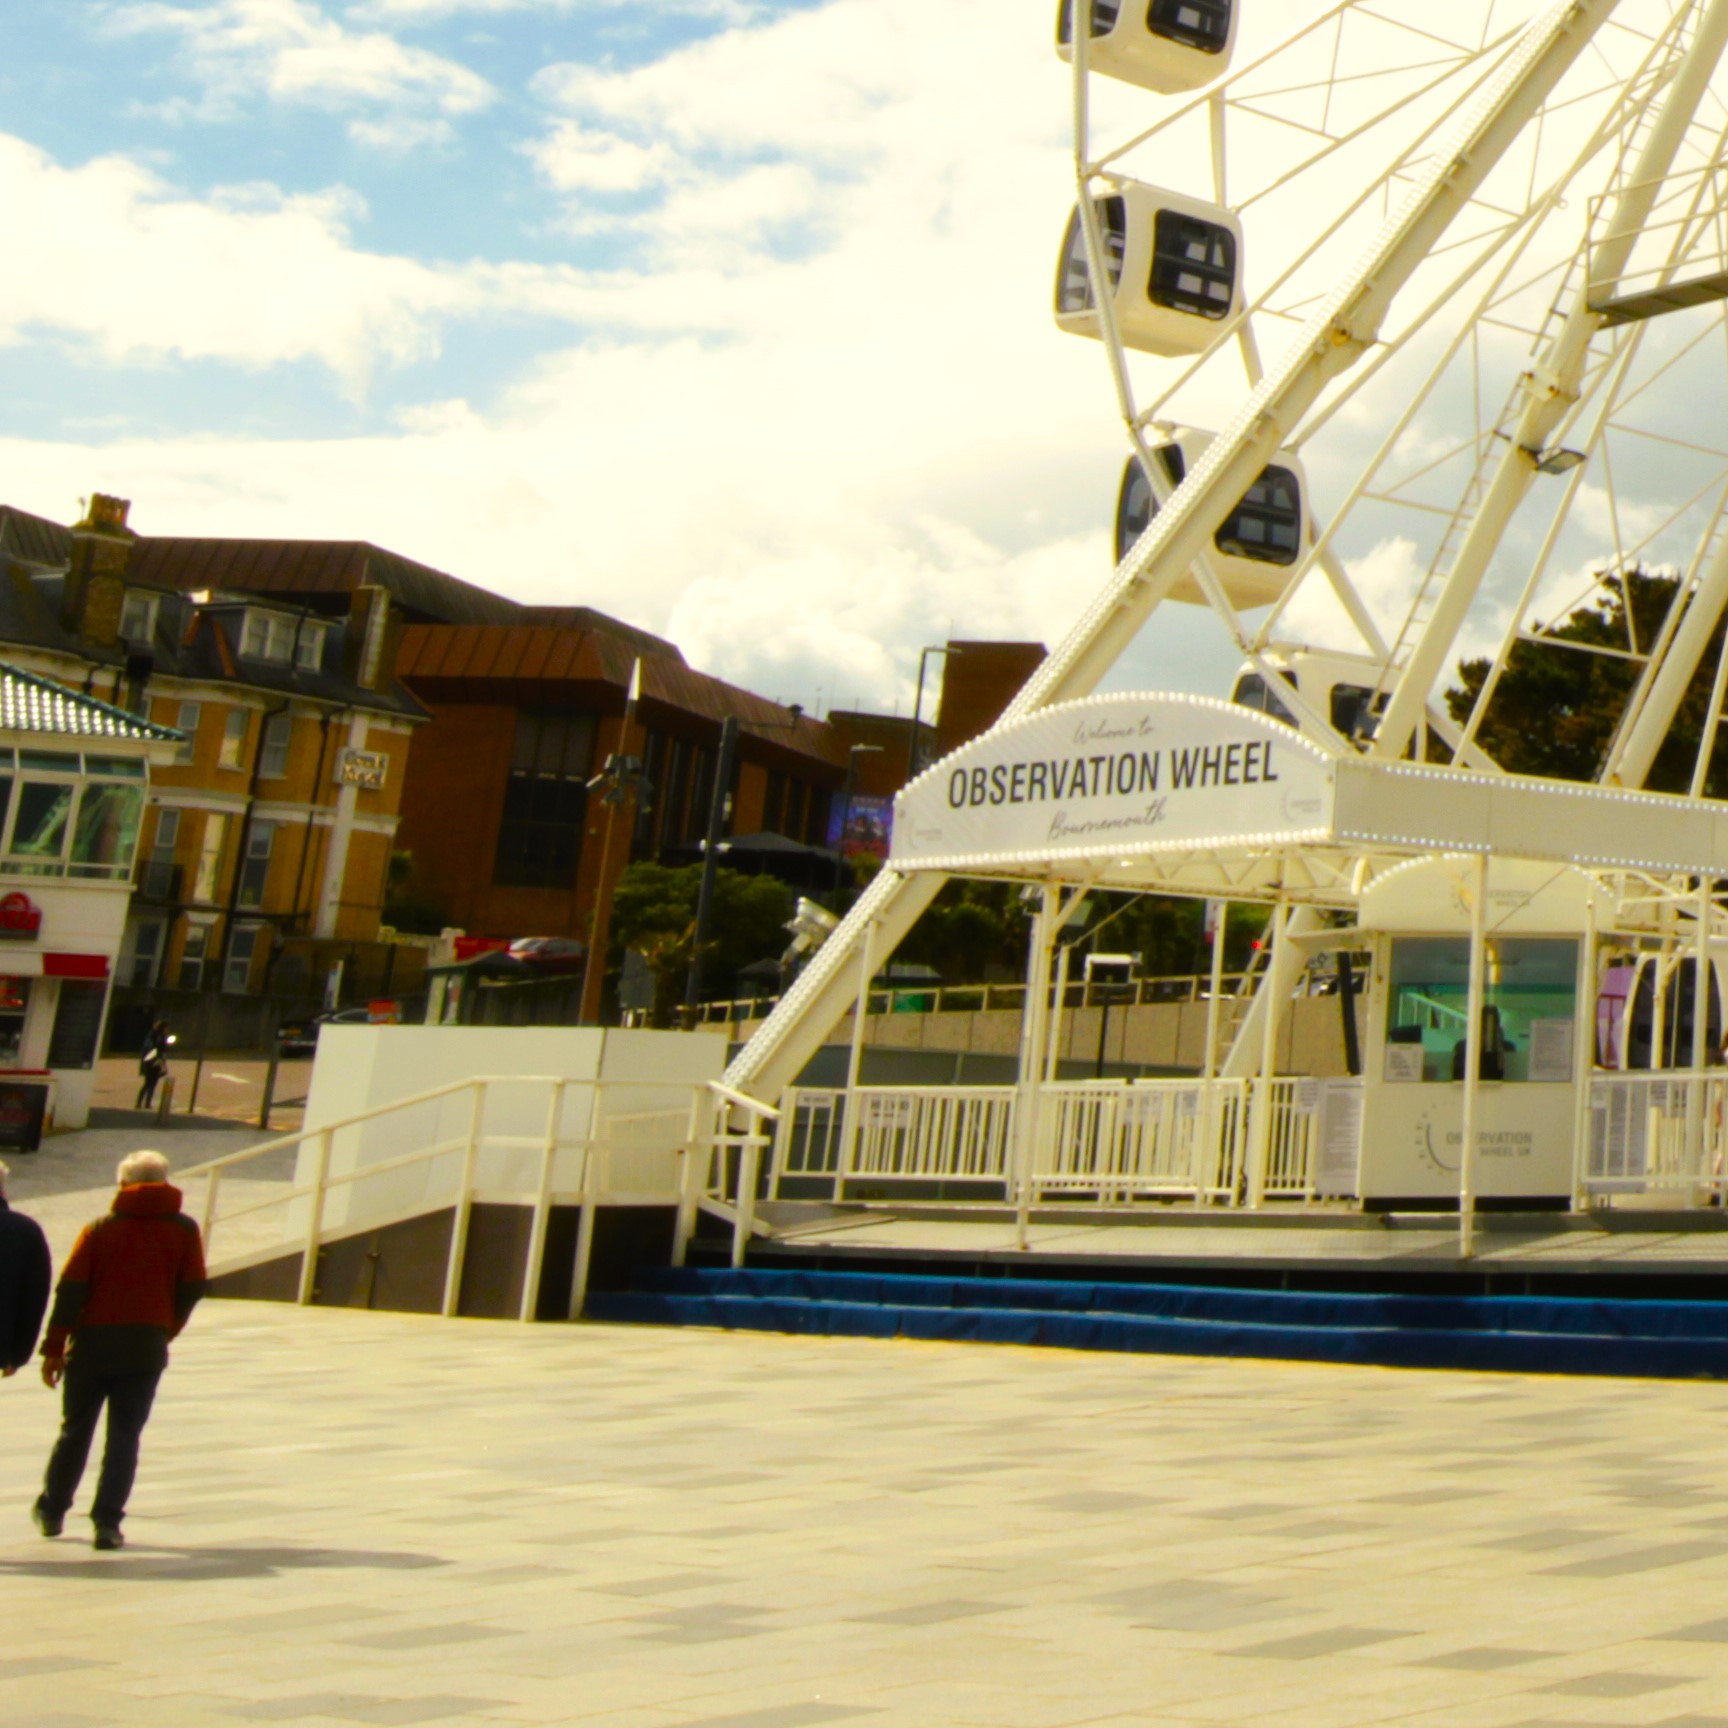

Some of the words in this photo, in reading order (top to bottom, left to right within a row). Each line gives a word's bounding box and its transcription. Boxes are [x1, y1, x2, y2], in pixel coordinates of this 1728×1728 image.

[1072, 718, 1134, 745] Welcome
[1138, 714, 1154, 736] to
[950, 749, 1160, 809] OBSERVATION
[1171, 741, 1279, 791] WHEEL
[1046, 795, 1168, 842] Bournemouth
[1446, 1131, 1532, 1145] OBRVATION
